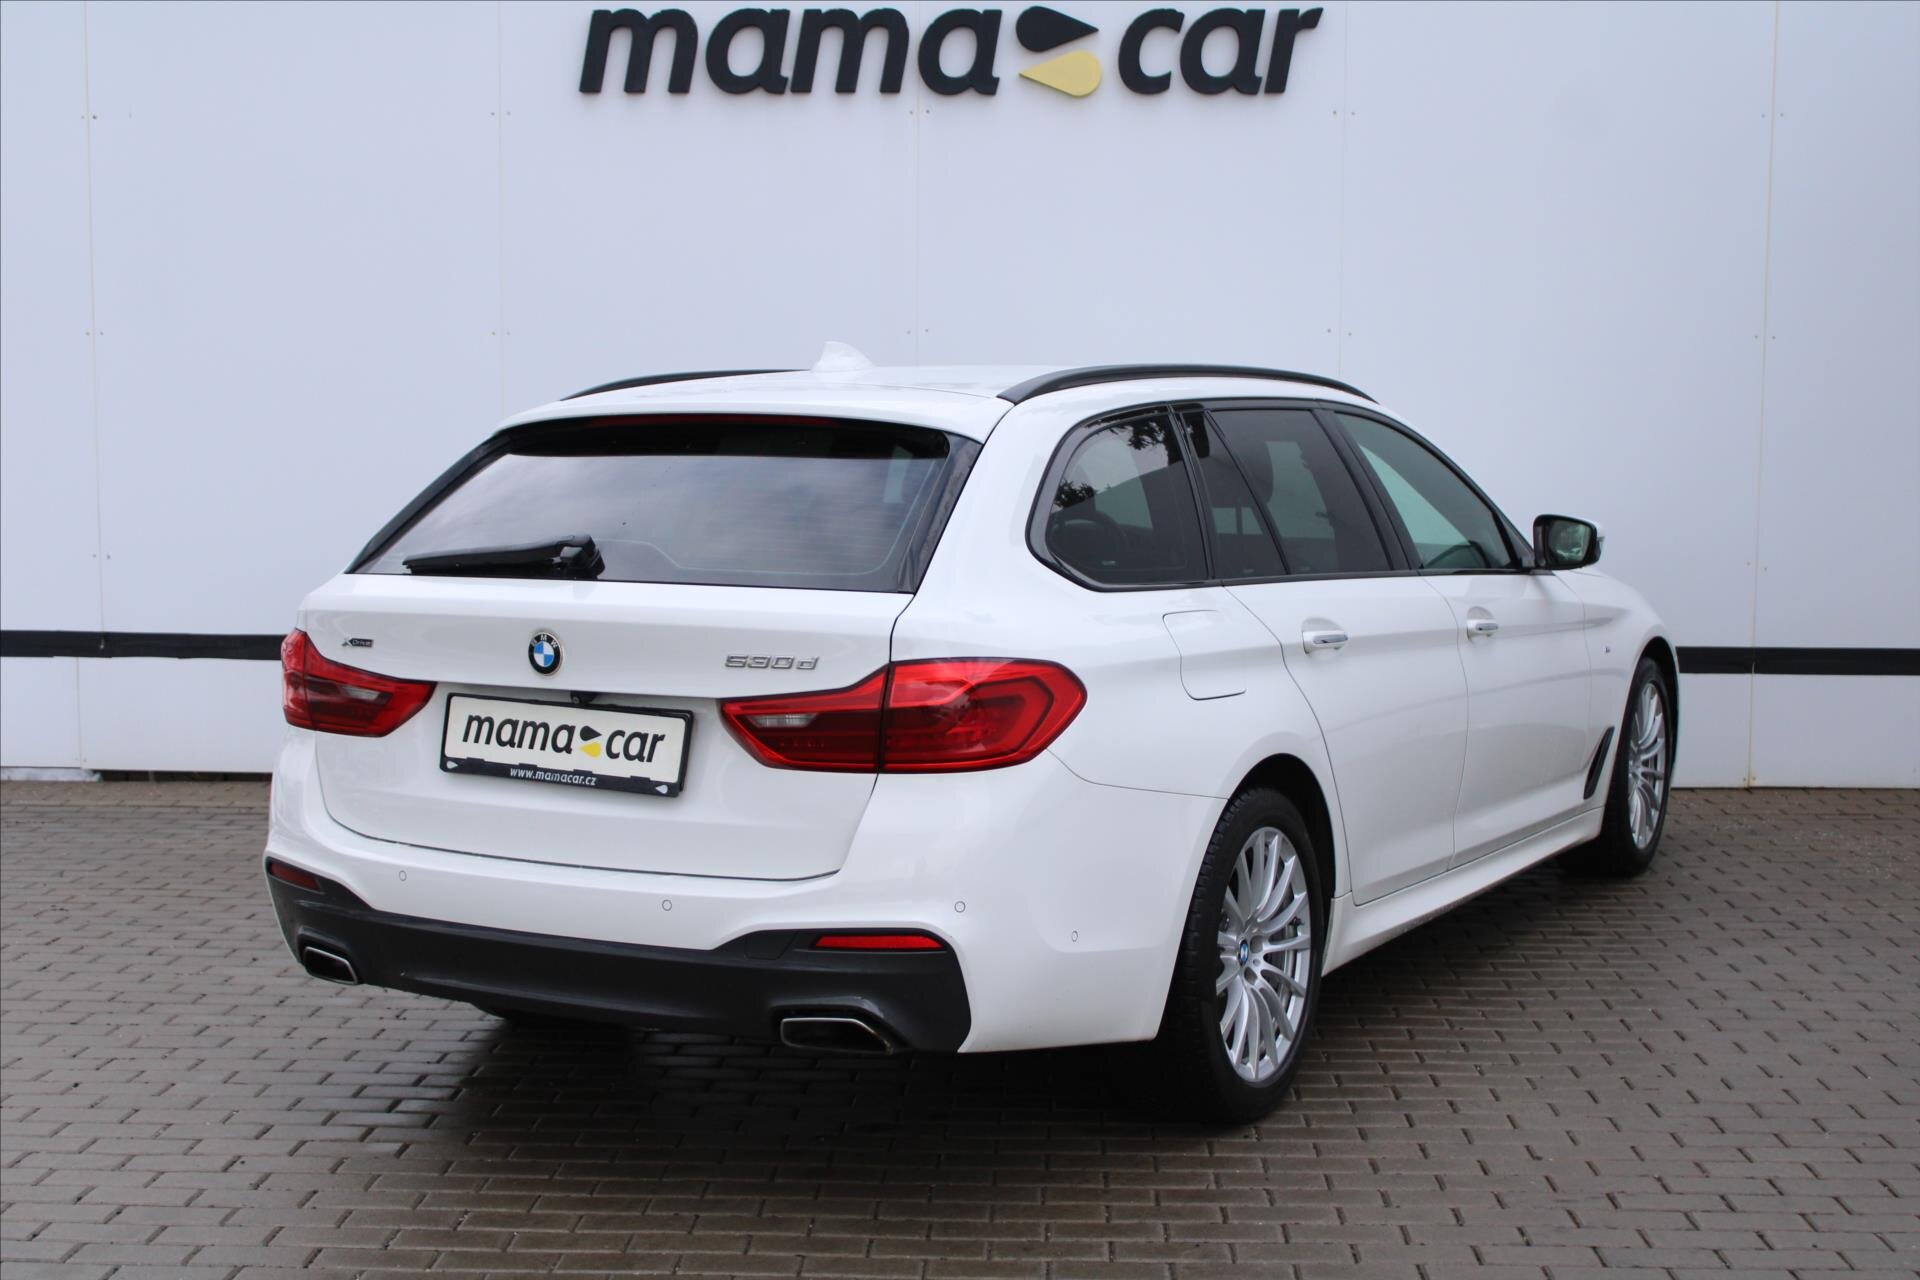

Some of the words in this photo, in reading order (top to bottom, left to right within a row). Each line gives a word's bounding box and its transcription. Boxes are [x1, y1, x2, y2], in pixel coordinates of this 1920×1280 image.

[579, 8, 1002, 96] mama
[1118, 8, 1323, 96] car
[462, 714, 576, 755] mama
[605, 729, 666, 763] car
[510, 767, 597, 786] www.mamacar.cz
